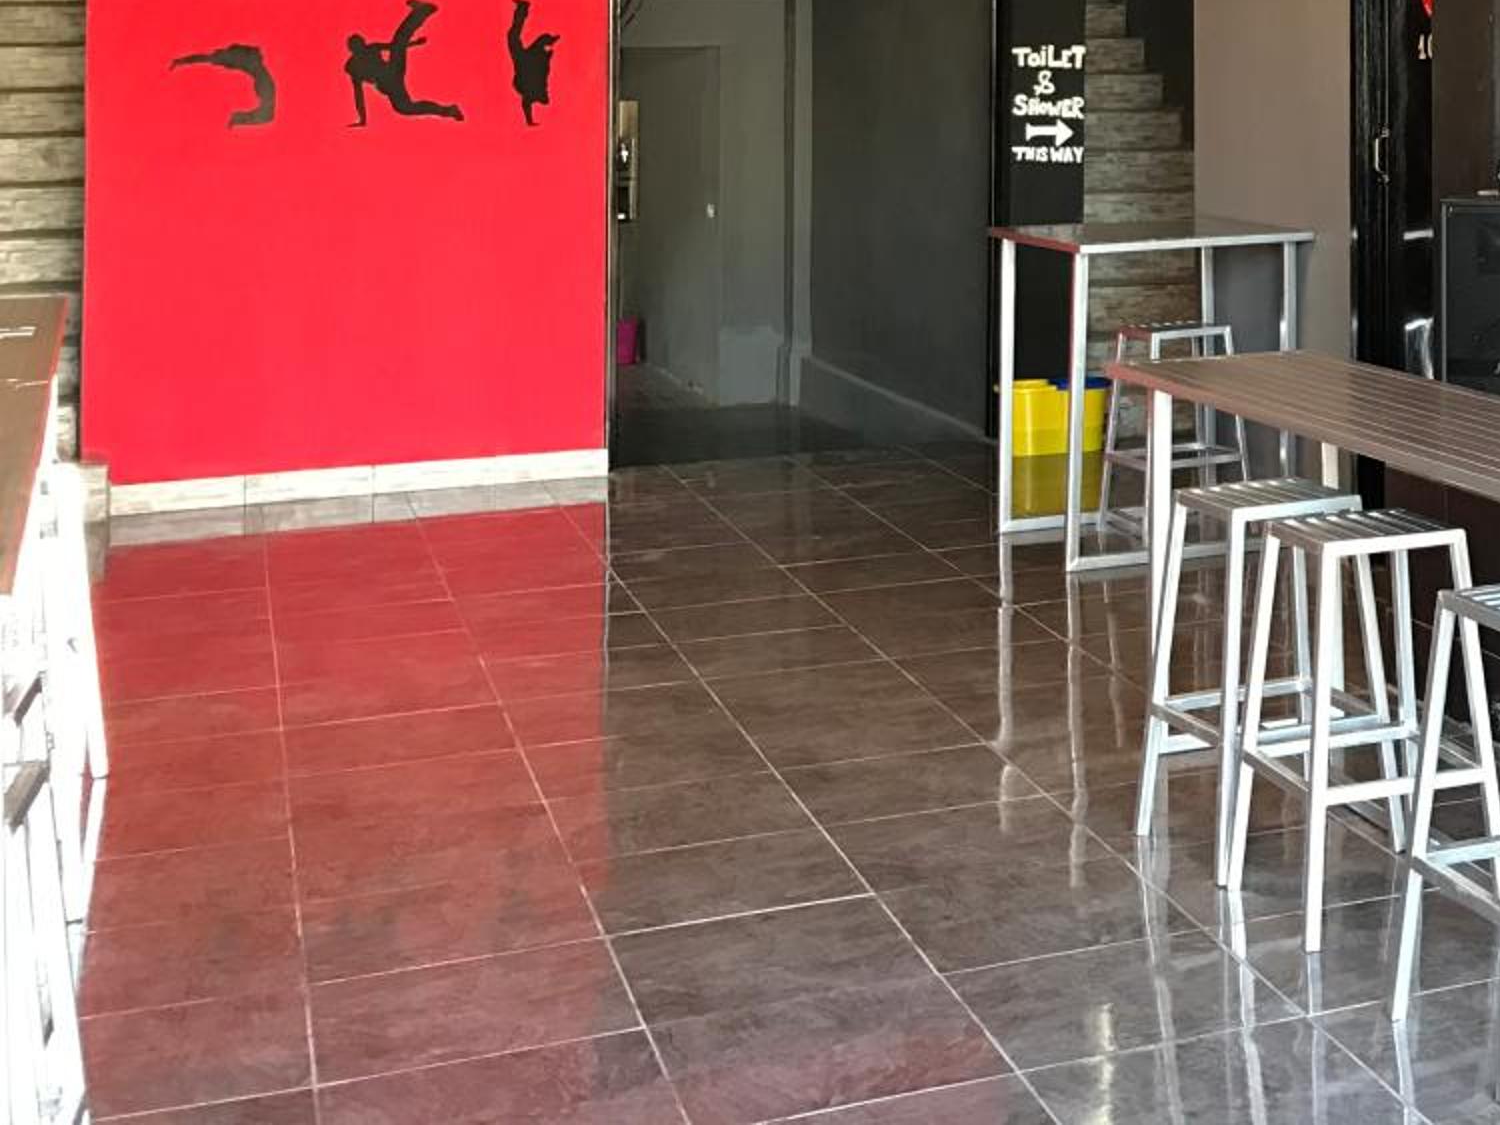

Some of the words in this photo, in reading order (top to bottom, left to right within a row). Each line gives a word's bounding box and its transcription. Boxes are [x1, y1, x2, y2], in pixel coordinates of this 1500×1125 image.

[1033, 69, 1055, 96] &
[1011, 146, 1048, 162] THIS
[1050, 146, 1084, 164] WAY
